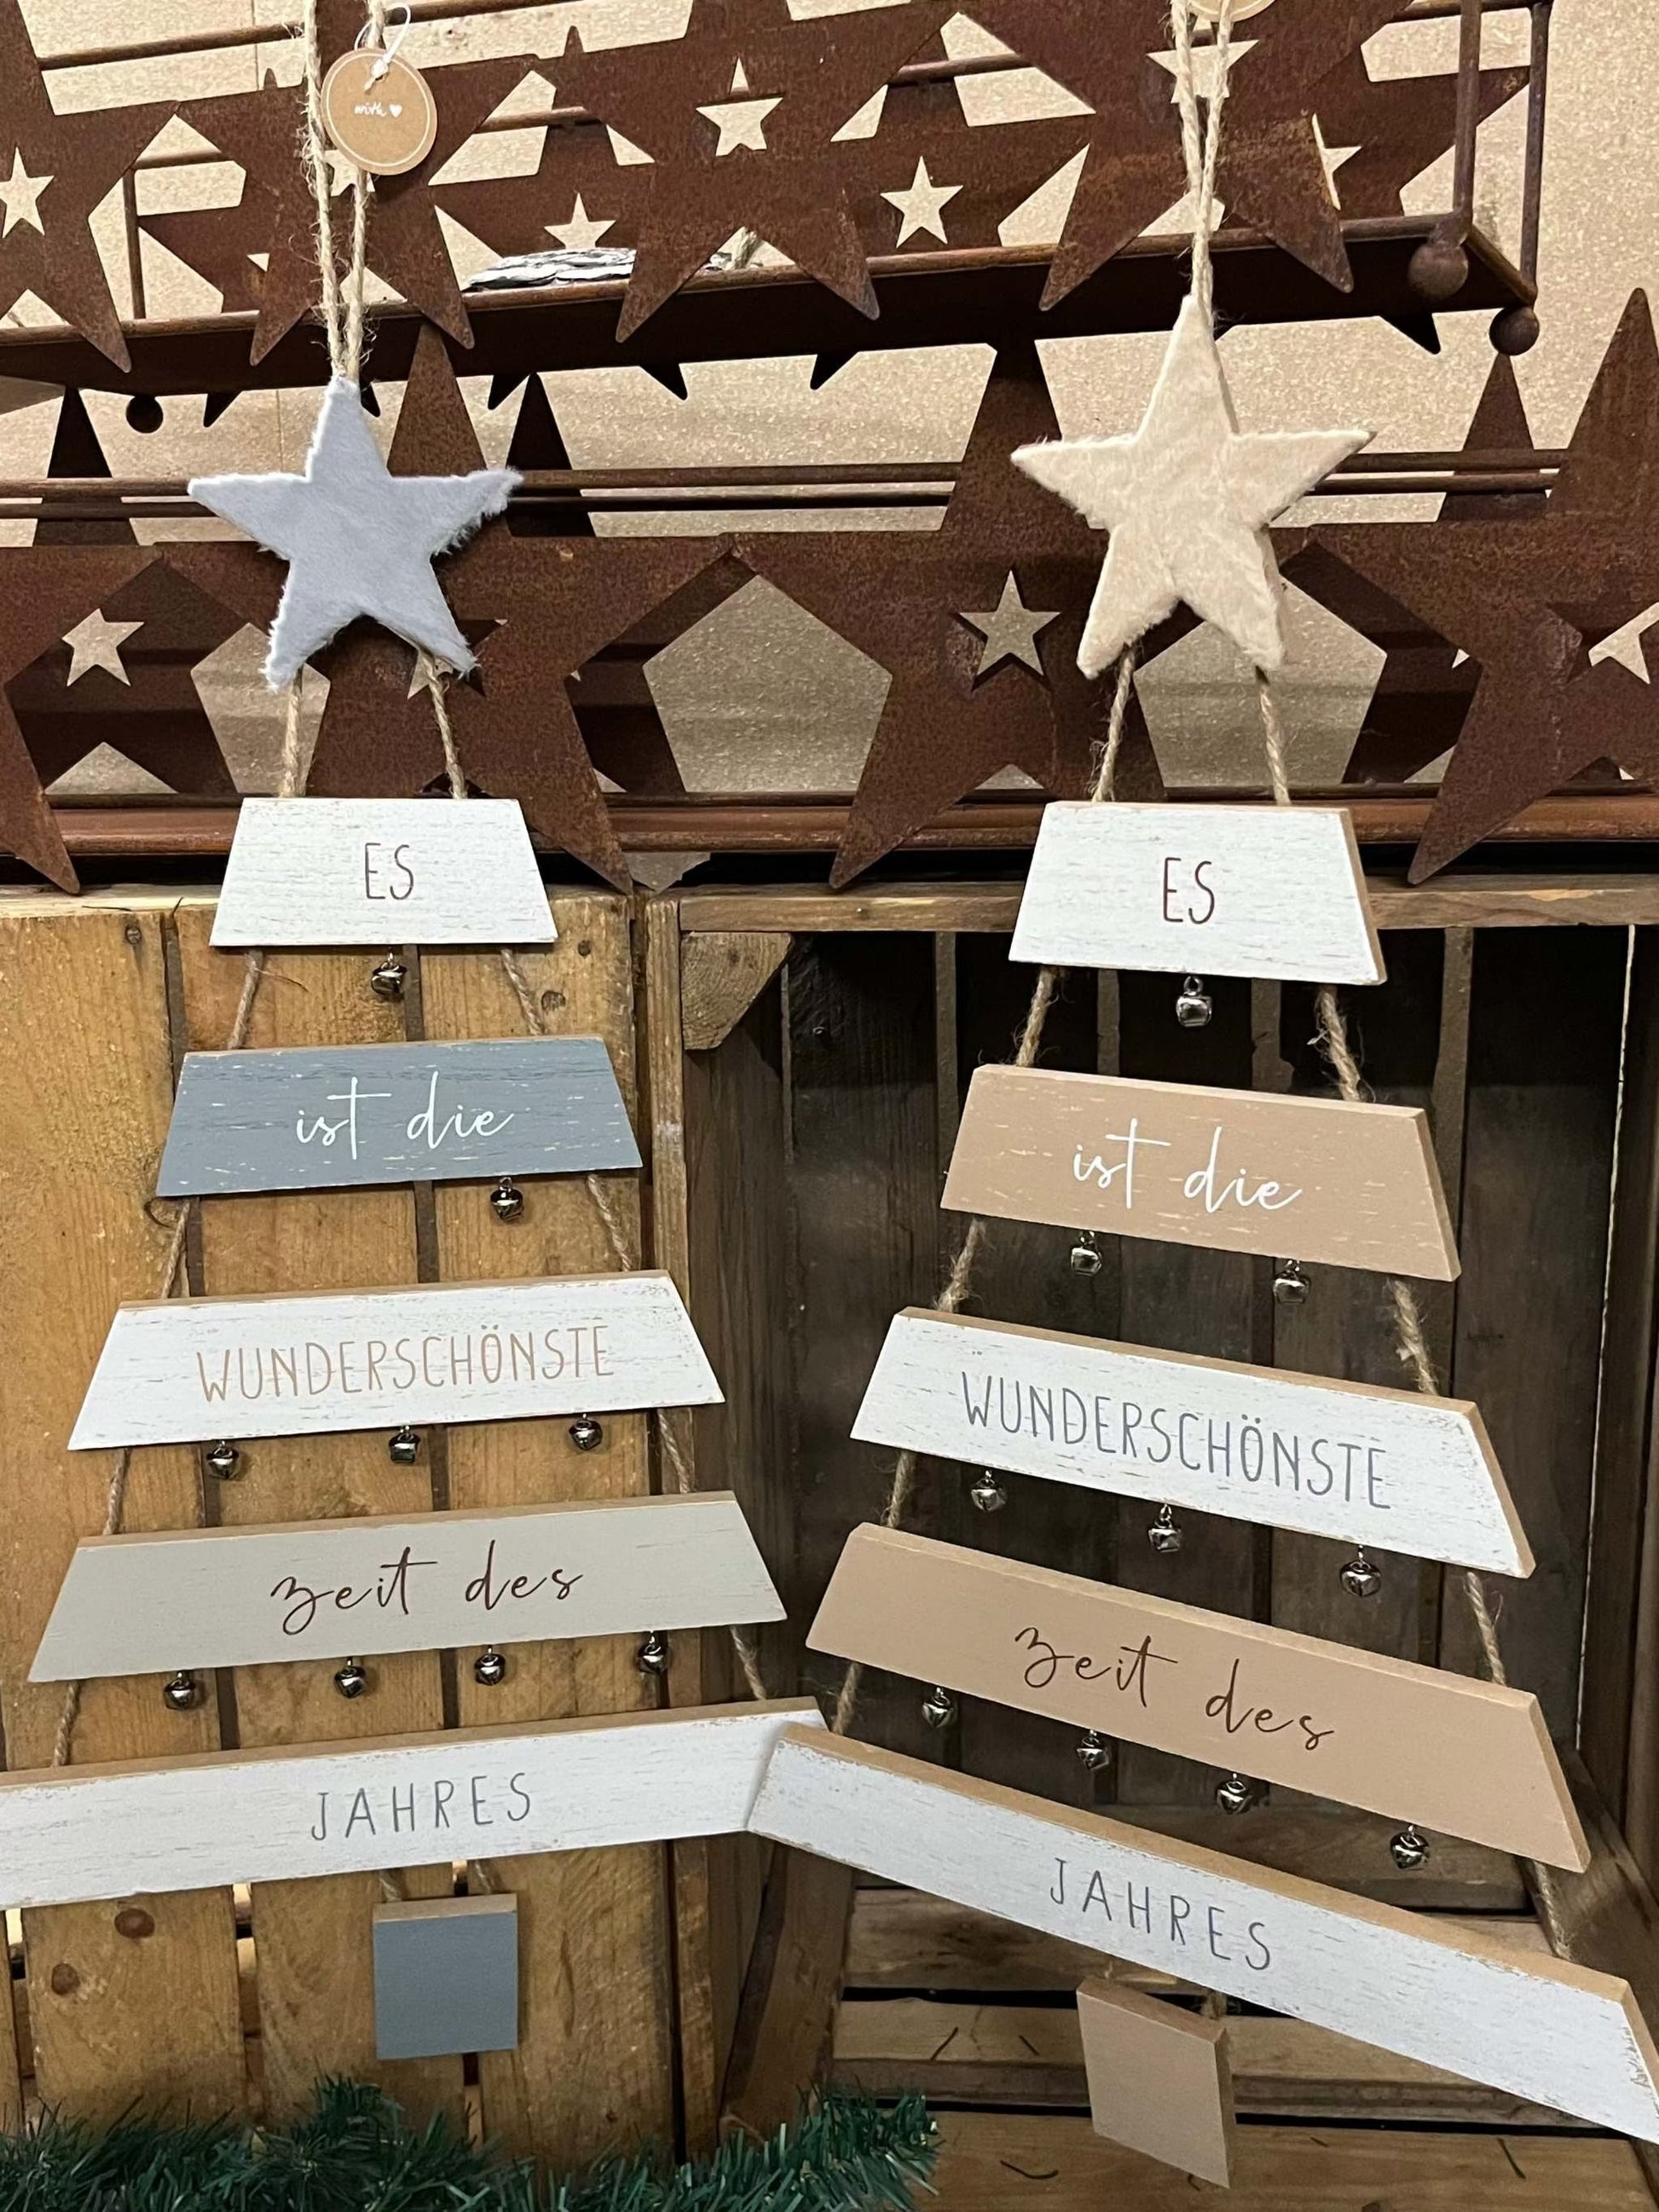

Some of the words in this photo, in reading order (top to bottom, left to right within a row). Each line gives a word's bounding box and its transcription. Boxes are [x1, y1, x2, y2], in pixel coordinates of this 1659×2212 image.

[364, 842, 414, 900] ES
[1162, 856, 1216, 925] ES
[296, 1076, 392, 1161] ist
[407, 1070, 514, 1149] die
[1072, 1117, 1172, 1209] ist
[1183, 1126, 1303, 1213] die
[197, 1323, 615, 1403] WUNDERSCHÖNSTE
[961, 1370, 1391, 1511] WUNDERSCHÖNSTE
[465, 1539, 583, 1612] des
[1205, 1658, 1335, 1752] des
[310, 1771, 532, 1842] JAHRES
[1049, 1856, 1271, 1972] JAHRES
